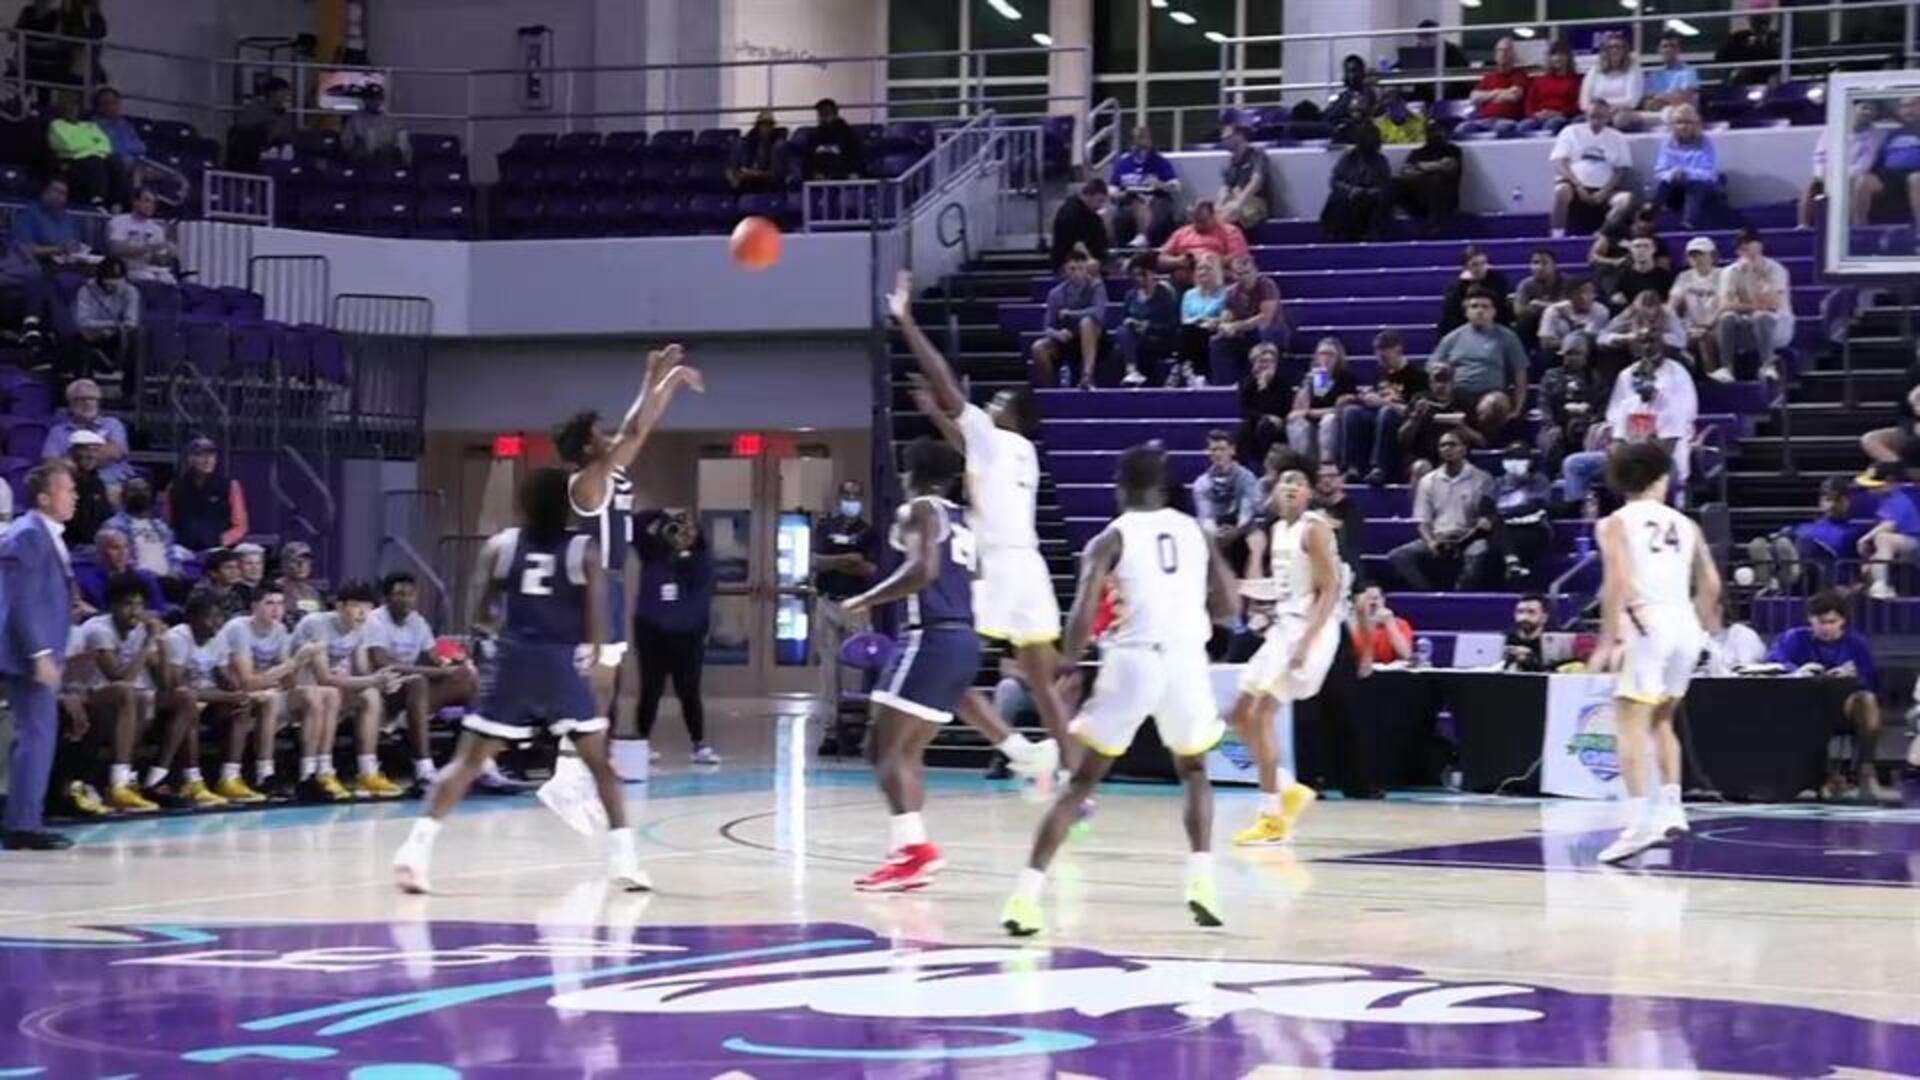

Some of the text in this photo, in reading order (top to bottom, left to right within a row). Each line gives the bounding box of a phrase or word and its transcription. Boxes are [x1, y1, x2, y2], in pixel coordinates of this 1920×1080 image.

[1157, 532, 1179, 575] 0
[1644, 519, 1681, 554] 24
[520, 552, 557, 596] 2
